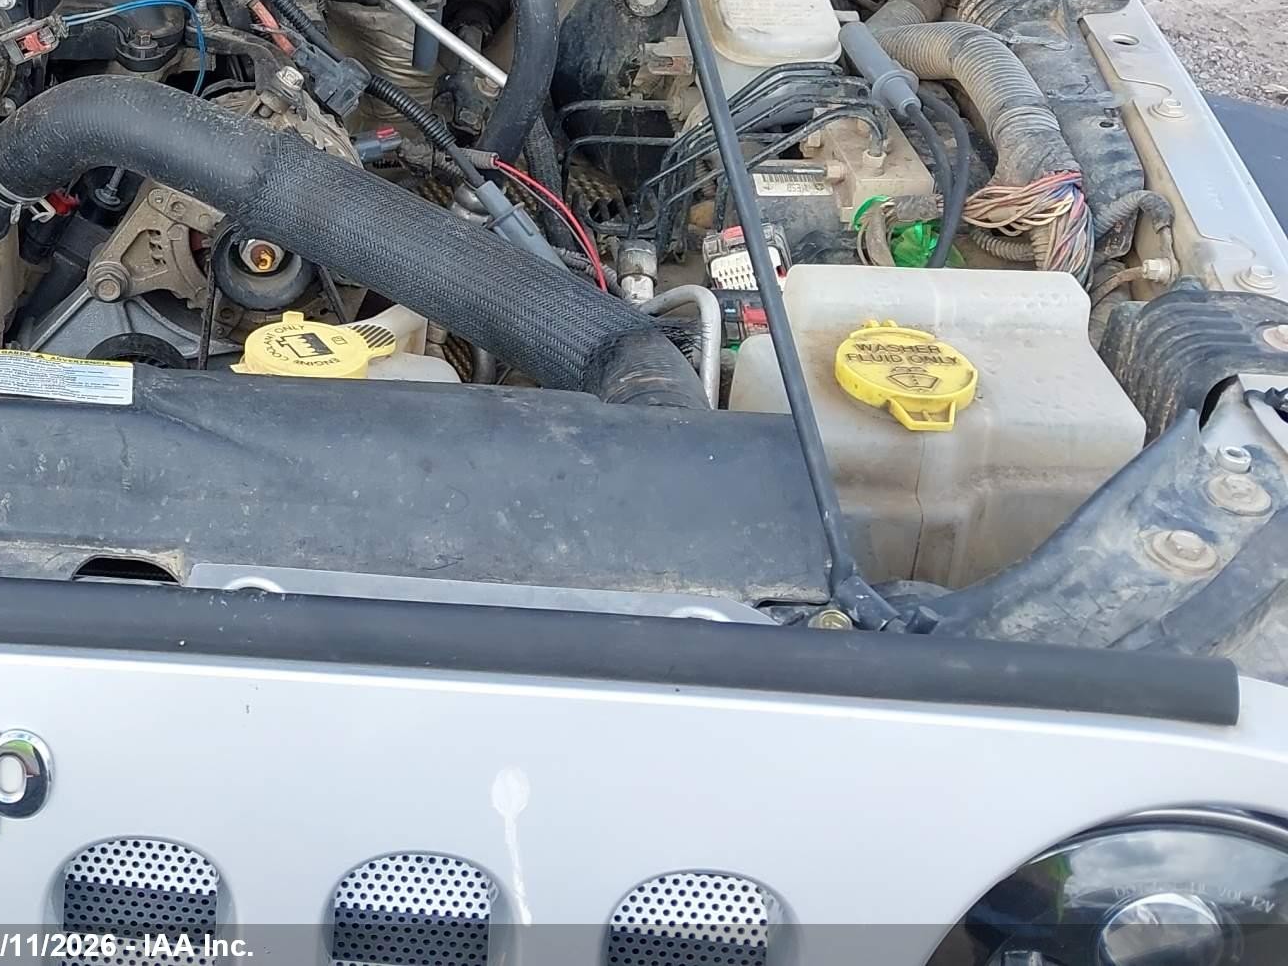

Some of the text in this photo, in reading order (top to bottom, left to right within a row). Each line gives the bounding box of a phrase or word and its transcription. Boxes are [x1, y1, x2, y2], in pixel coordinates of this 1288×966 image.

[274, 324, 305, 334] ONLY
[855, 343, 942, 354] WASHER
[846, 353, 958, 365] FLUID ONLY
